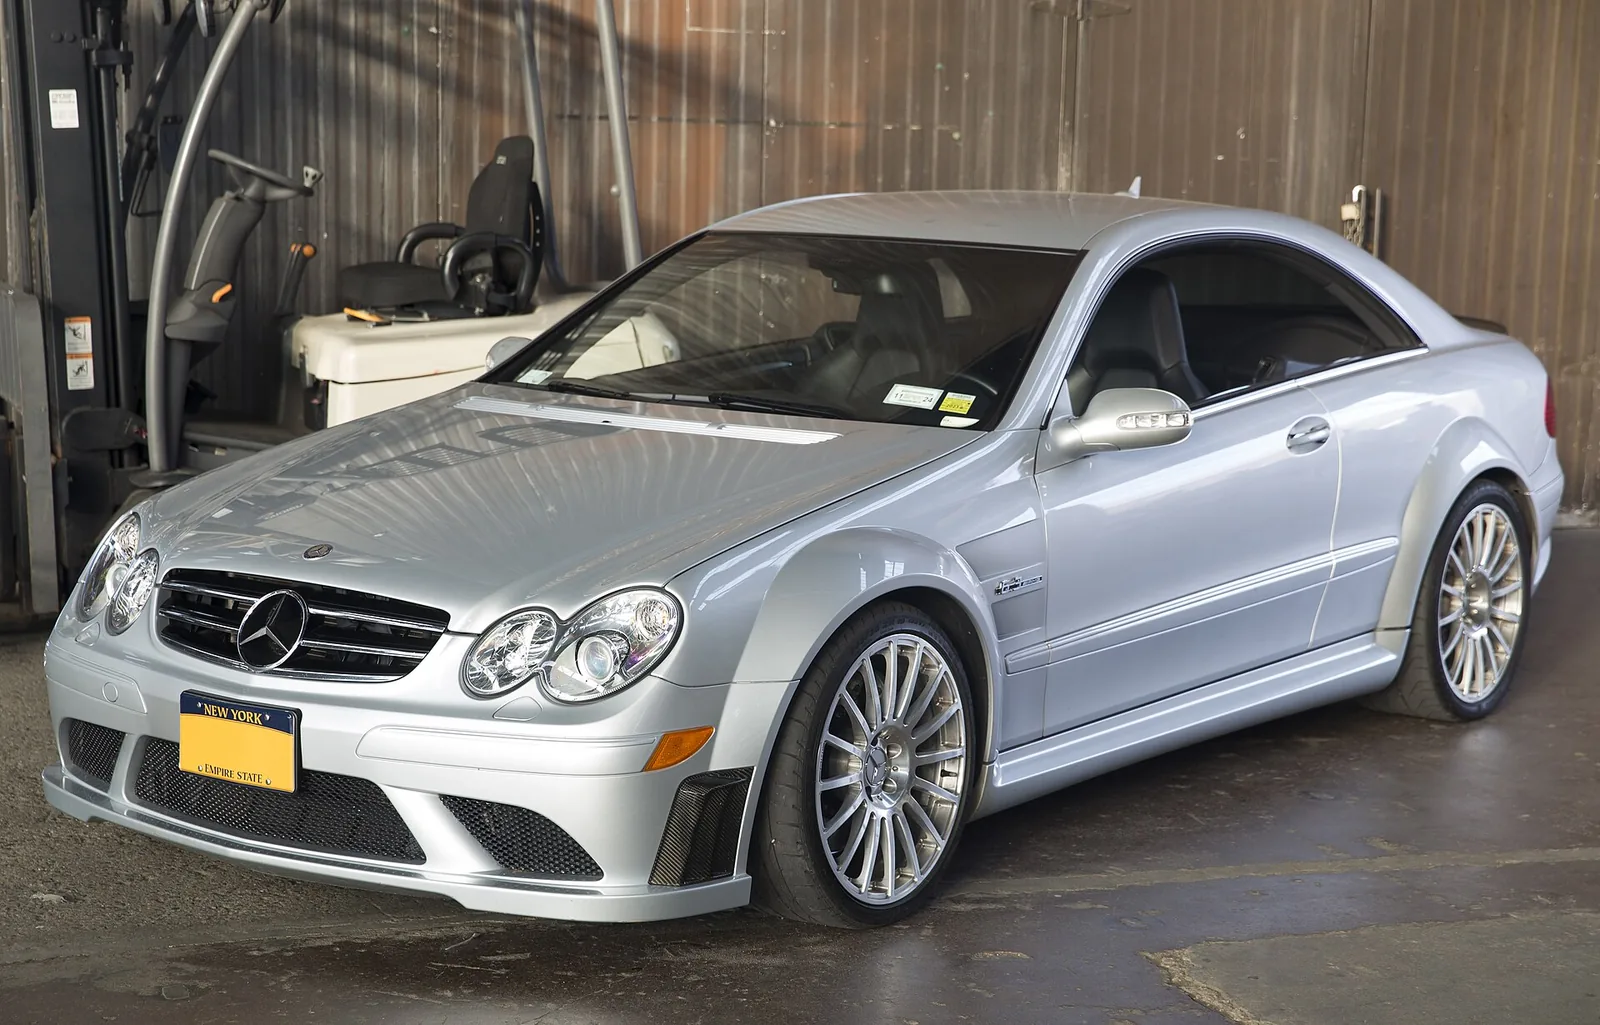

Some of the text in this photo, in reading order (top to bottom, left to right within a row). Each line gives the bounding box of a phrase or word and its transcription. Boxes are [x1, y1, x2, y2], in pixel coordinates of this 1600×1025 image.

[203, 703, 263, 725] NEW YORK
[204, 763, 263, 784] EMPIRE STATE
